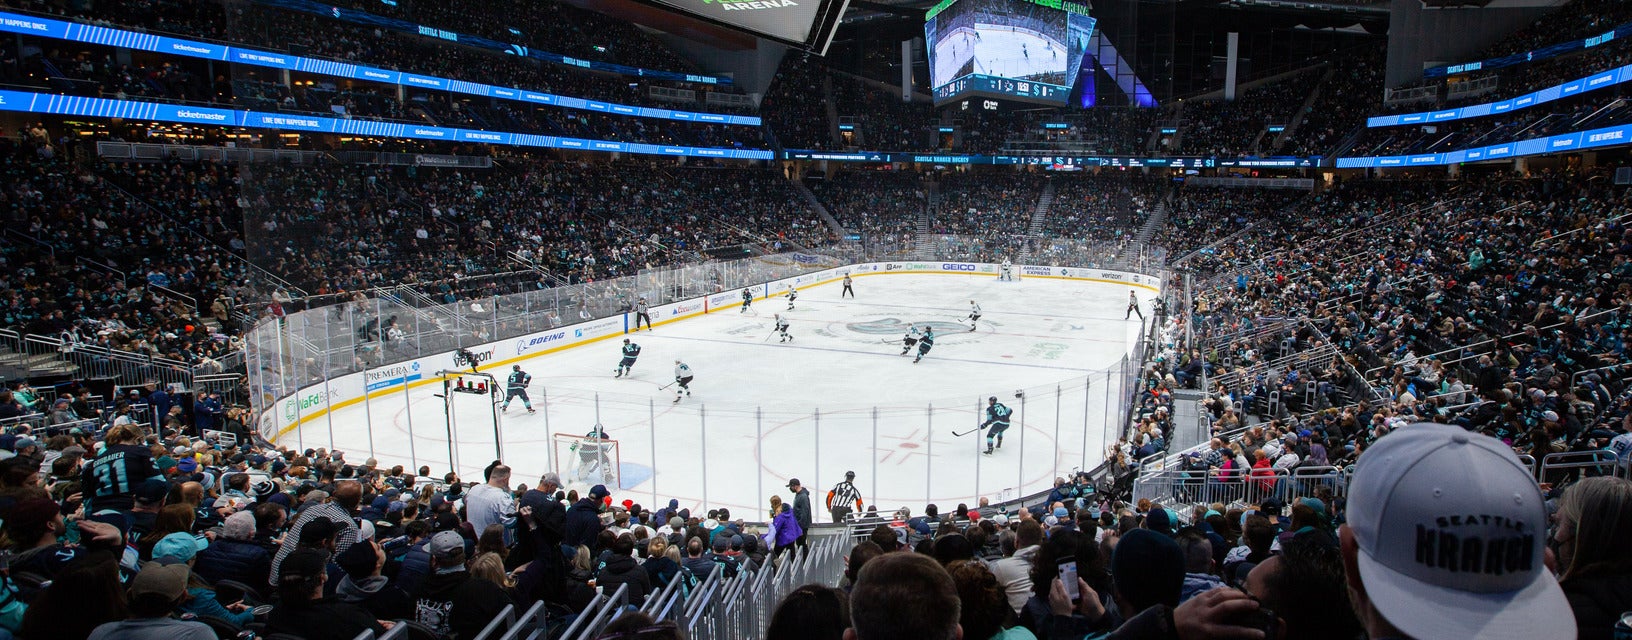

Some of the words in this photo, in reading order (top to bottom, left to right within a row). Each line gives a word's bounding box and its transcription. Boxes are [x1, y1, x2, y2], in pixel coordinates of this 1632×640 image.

[722, 0, 798, 11] ARENA
[1062, 1, 1089, 16] ARENA
[5, 18, 31, 29] HAPPENS
[173, 43, 211, 54] ticketmaster
[177, 110, 226, 121] ticketmaster
[415, 129, 444, 137] ticketmaster
[942, 263, 976, 271] GEICO
[1101, 271, 1122, 280] verizon
[529, 332, 565, 346] BOEING
[367, 366, 409, 382] PREMERA
[93, 459, 129, 496] 31
[1436, 514, 1525, 533] SEATTLE
[1415, 523, 1535, 577] KRAKEN
